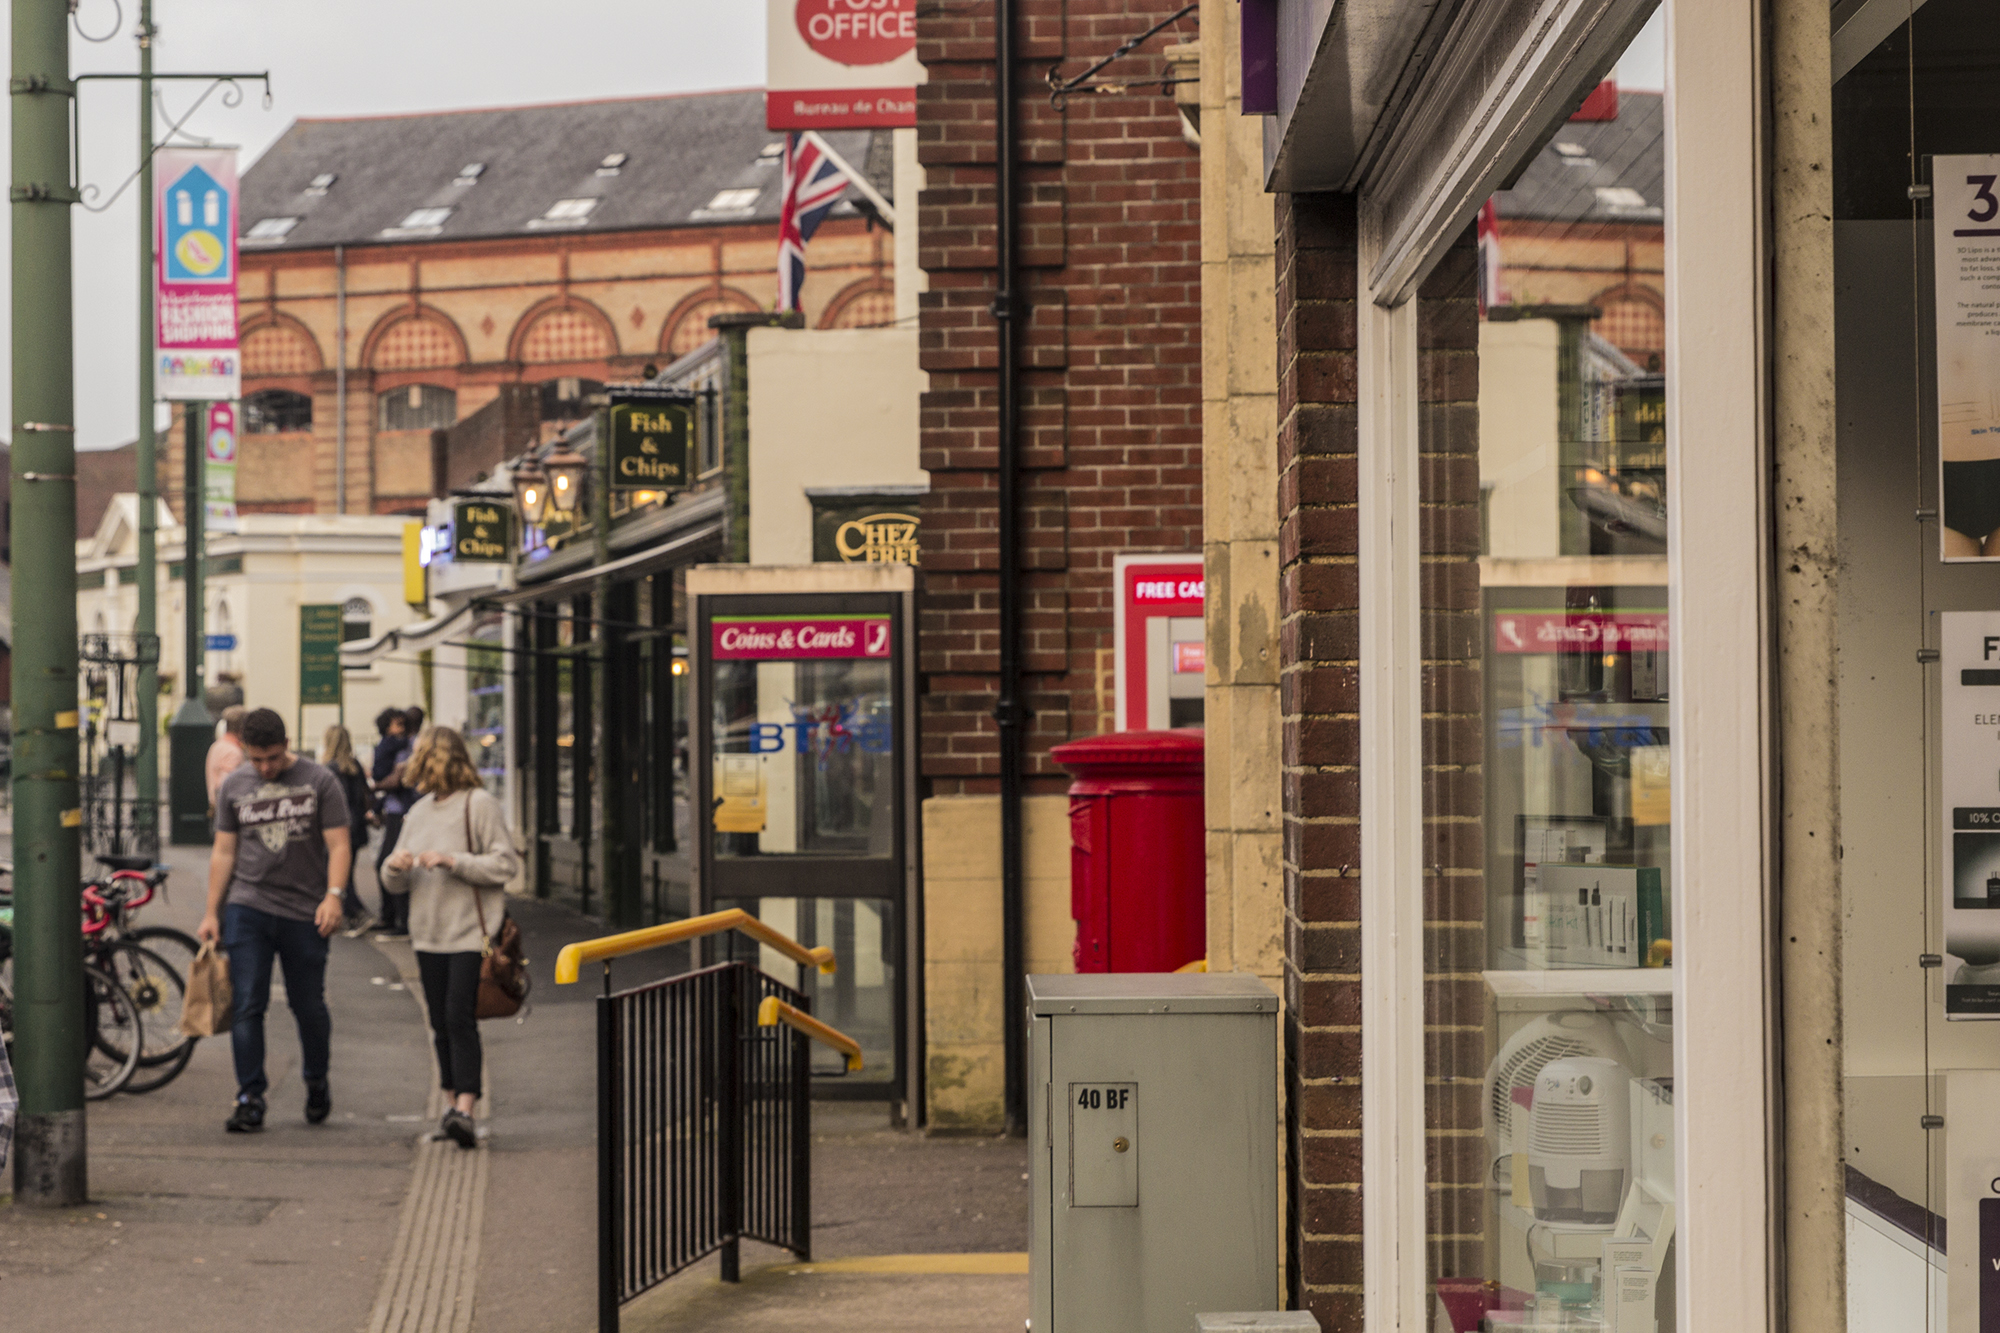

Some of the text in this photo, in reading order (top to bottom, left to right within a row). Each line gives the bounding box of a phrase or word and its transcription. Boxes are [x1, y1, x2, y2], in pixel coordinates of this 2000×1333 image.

[808, 11, 916, 41] OFFICE
[793, 100, 849, 116] Bureau
[852, 99, 873, 115] de
[630, 411, 673, 433] Fish
[640, 436, 660, 455] &
[620, 455, 680, 480] Chips
[466, 506, 499, 524] Fish
[473, 524, 489, 539] &
[835, 521, 917, 558] CHEZ
[459, 538, 505, 558] Chips
[1136, 581, 1176, 599] FREE
[720, 626, 856, 650] Coins & Cards
[1975, 714, 2000, 725] ELE
[750, 722, 822, 753] BT
[1969, 812, 1990, 824] 10%
[1078, 1088, 1129, 1110] 40 BF
